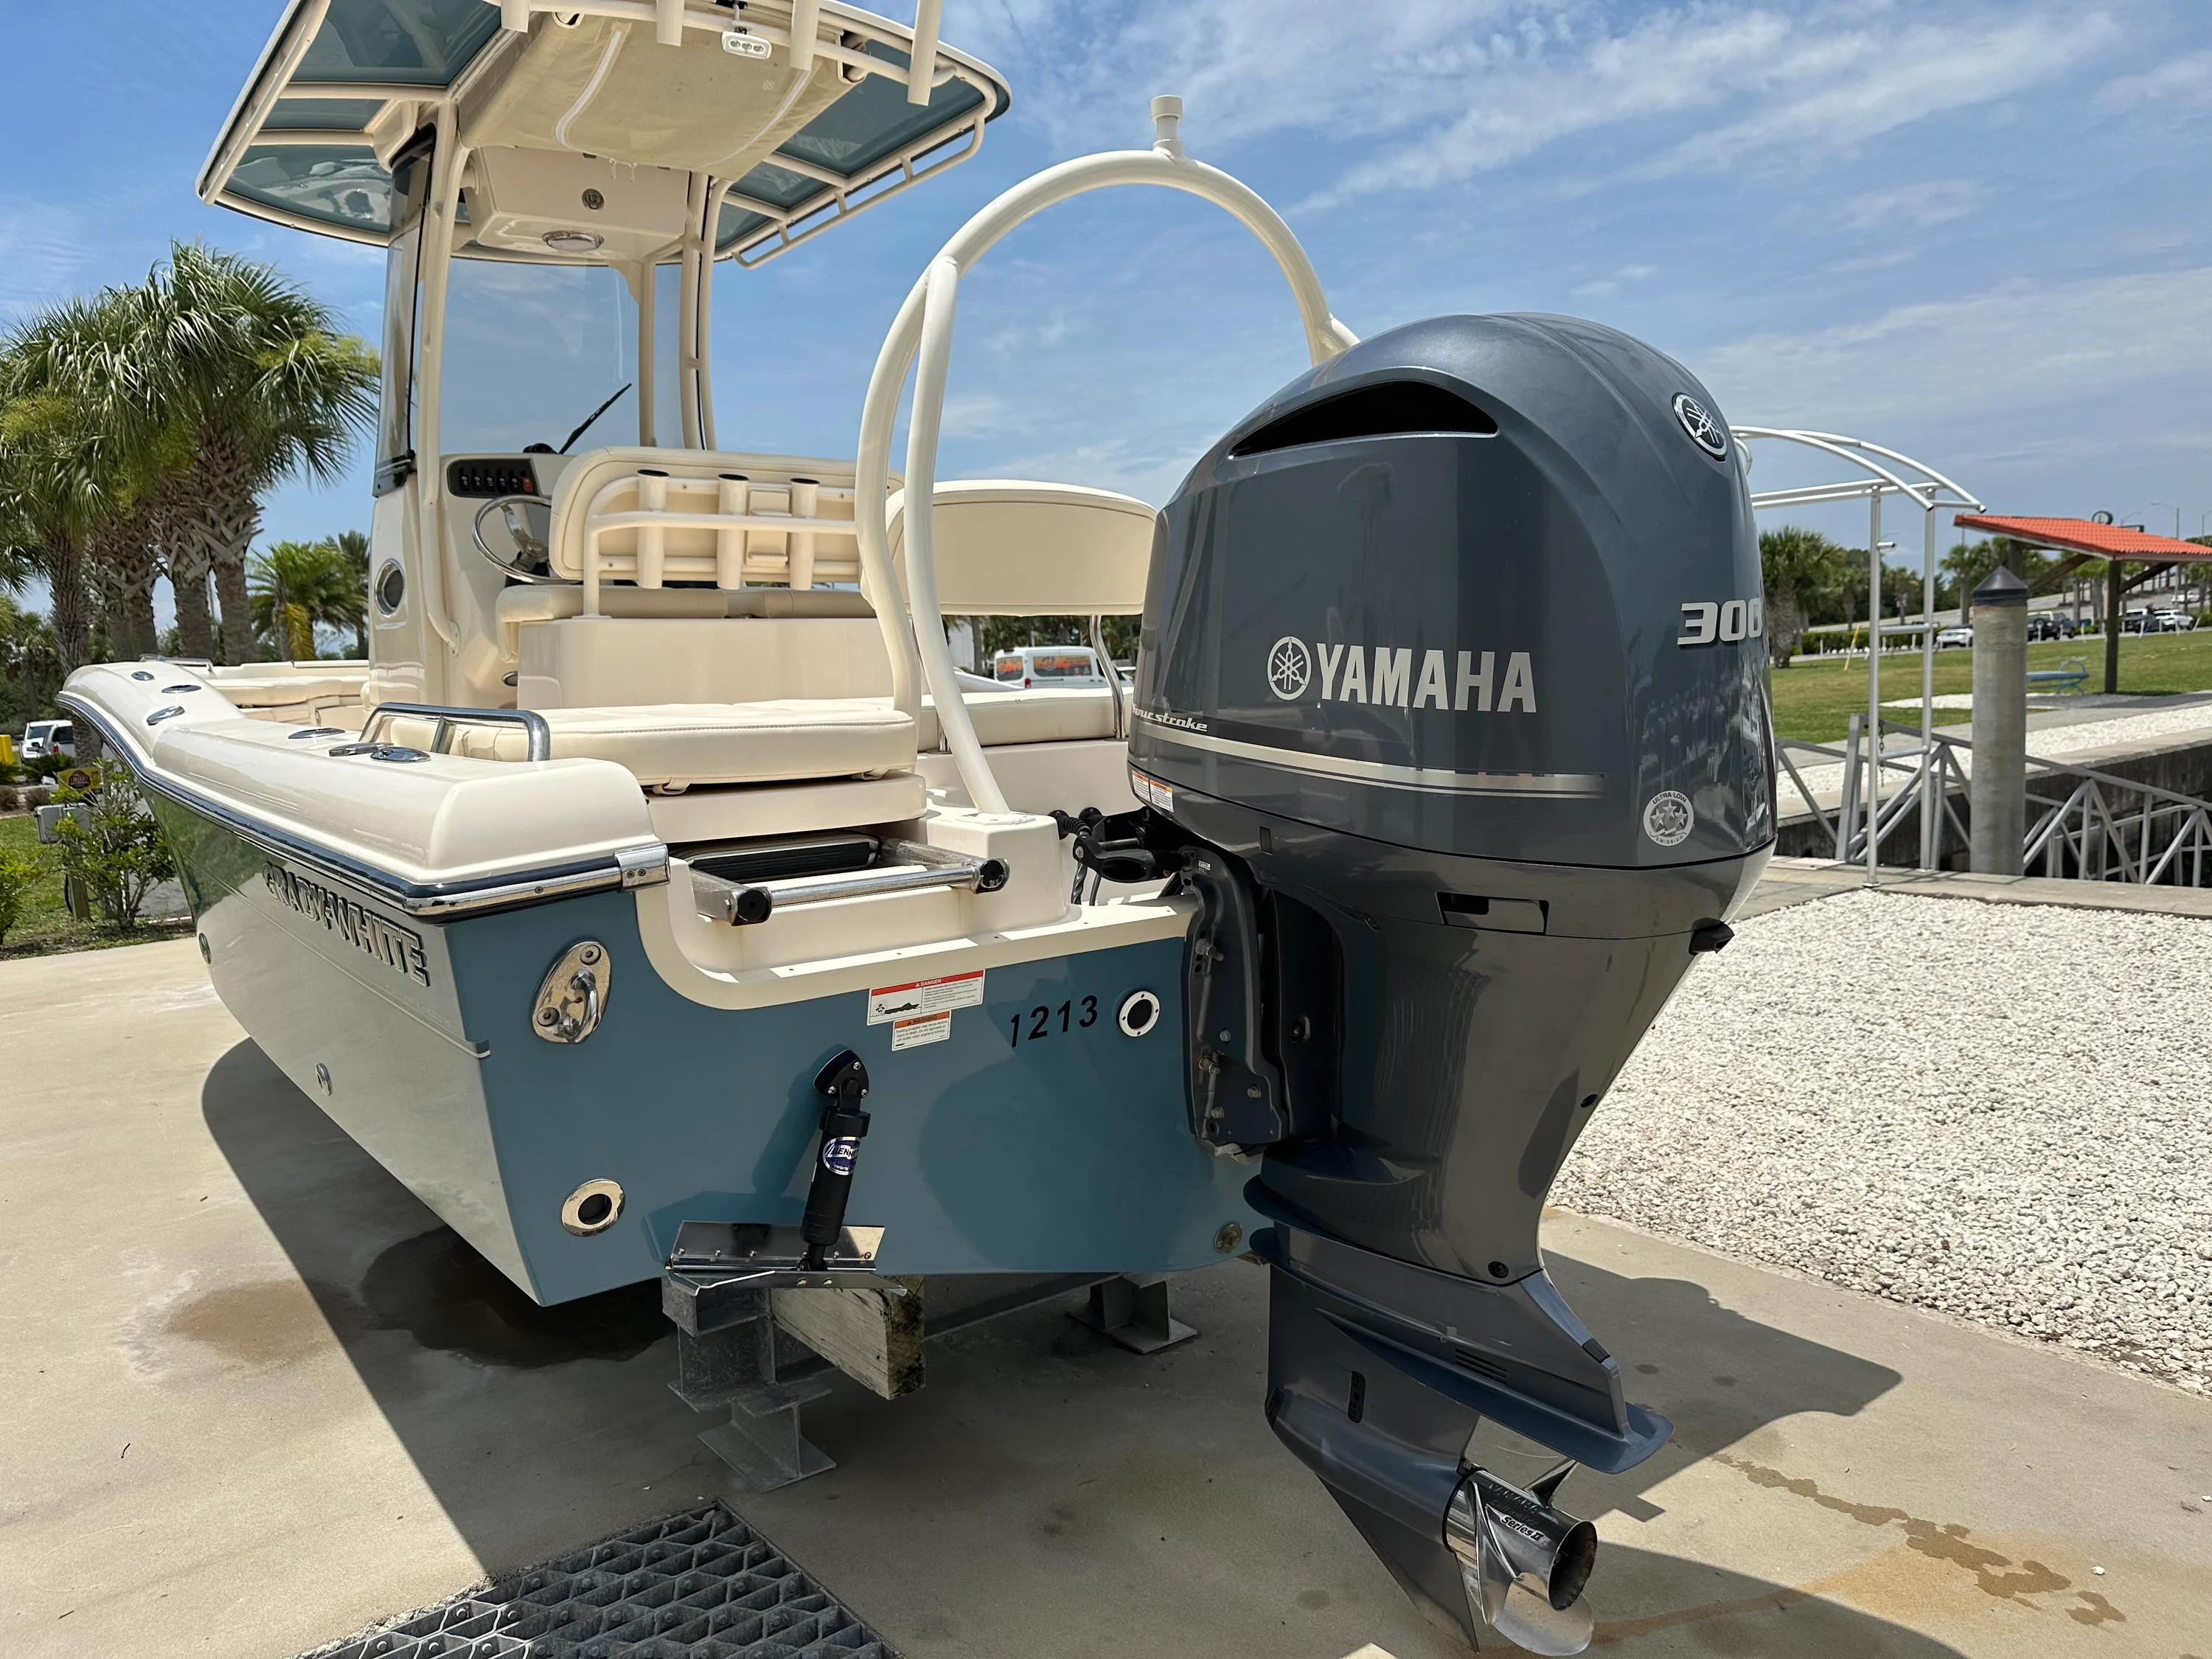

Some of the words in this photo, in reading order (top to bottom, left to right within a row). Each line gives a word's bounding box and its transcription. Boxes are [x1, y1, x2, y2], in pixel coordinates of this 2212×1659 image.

[1677, 598, 1762, 645] 300
[1316, 643, 1537, 713] YAMAHA
[1652, 792, 1687, 804] ULTRA-LOW
[262, 860, 431, 987] GRADY-WHITE
[920, 978, 942, 987] DANGER
[913, 1015, 938, 1024] WARNING
[1010, 995, 1098, 1048] 1213
[1500, 1516, 1533, 1536] Series
